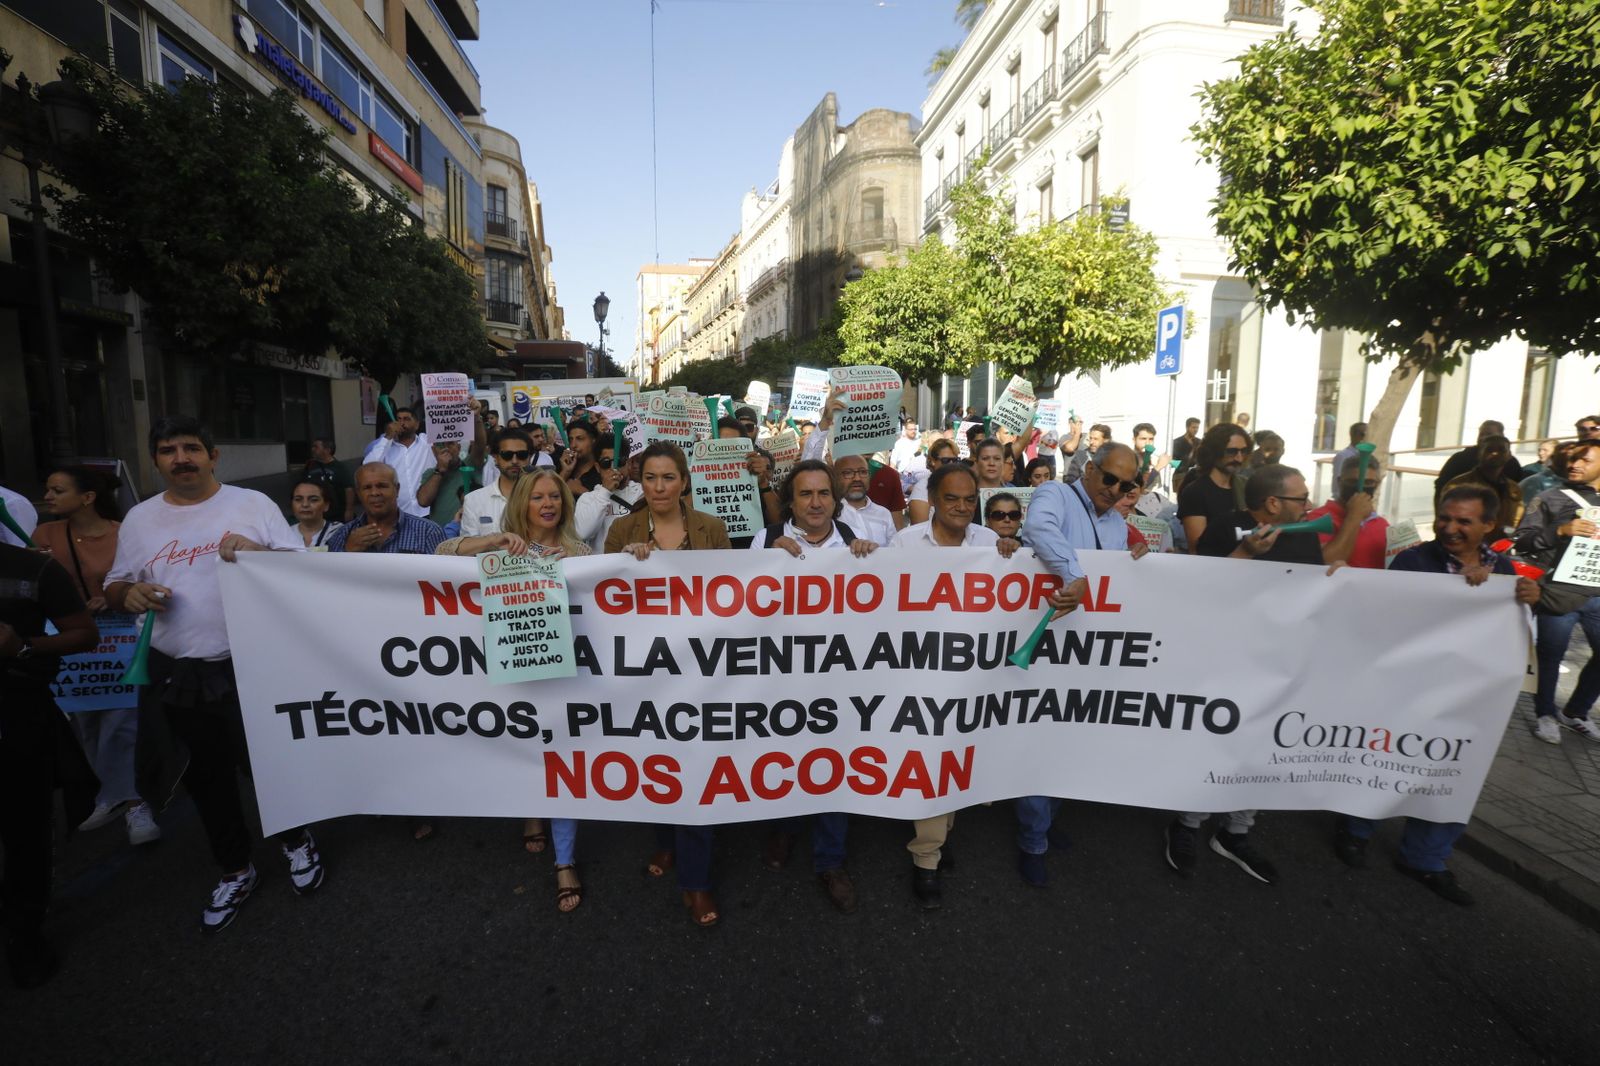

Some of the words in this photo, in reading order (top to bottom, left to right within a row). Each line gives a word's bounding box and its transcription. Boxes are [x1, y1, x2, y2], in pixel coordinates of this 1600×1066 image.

[1160, 313, 1179, 352] P
[835, 381, 900, 392] AMBULANTES
[796, 393, 821, 401] CONTRA
[850, 391, 886, 401] UNIDOS
[848, 404, 884, 414] SOMOS
[1007, 398, 1030, 412] CONTRA
[428, 409, 472, 418] QUEREMOS
[431, 416, 468, 424] DIALOGO
[841, 412, 890, 423] FAMILIAS,
[996, 411, 1022, 427] LABORAL
[998, 405, 1028, 423] GENOCIDIO
[646, 417, 692, 428] AMBULAN
[840, 424, 854, 432] NO
[856, 420, 891, 431] SOMOS
[1000, 418, 1022, 433] SECTOR
[436, 431, 464, 440] ACOSO
[657, 428, 690, 436] UNIDOS
[833, 427, 897, 444] DELINCUENTES
[707, 443, 750, 452] Comacor
[690, 462, 747, 473] AMBULANTE
[705, 471, 740, 480] UNIDOS
[695, 487, 711, 495] SR.
[702, 496, 712, 505] NI
[742, 493, 752, 501] NI
[716, 505, 728, 513] SE
[730, 505, 741, 513] LE
[727, 524, 751, 533] JESE.
[502, 554, 555, 571] Comor
[417, 580, 483, 616] NO
[593, 573, 884, 618] GENOCIDIO
[502, 592, 546, 606] UNIDOS
[488, 607, 544, 622] EXIGIMOS
[546, 605, 562, 615] UN
[507, 619, 547, 632] TRATO
[497, 630, 560, 646] MUNICIPAL
[381, 635, 602, 677] CONA
[614, 635, 682, 677] LA
[688, 633, 857, 677] VENTA
[862, 630, 1162, 672] AMBULANTE:
[512, 643, 549, 656] JUSTO
[59, 660, 125, 672] CONTRA
[500, 660, 509, 670] Y
[512, 654, 563, 669] HUMANO
[71, 684, 135, 697] SECTOR
[275, 691, 553, 744] TÉCNICOS,
[567, 698, 838, 741] PLACEROS
[849, 695, 886, 731] Y
[890, 688, 1241, 736] AYUNTAMIENTO
[1273, 711, 1472, 761] Comacor
[1268, 750, 1335, 765] Asociación
[1338, 751, 1356, 764] de
[1361, 753, 1462, 777] Comerciantes
[543, 750, 683, 805] NOS
[698, 745, 975, 805] ACOSAN
[1204, 770, 1281, 785] Autónomos
[1284, 769, 1363, 785] Ambulantes
[1367, 776, 1389, 791] de
[1394, 780, 1454, 796] Córdoba
